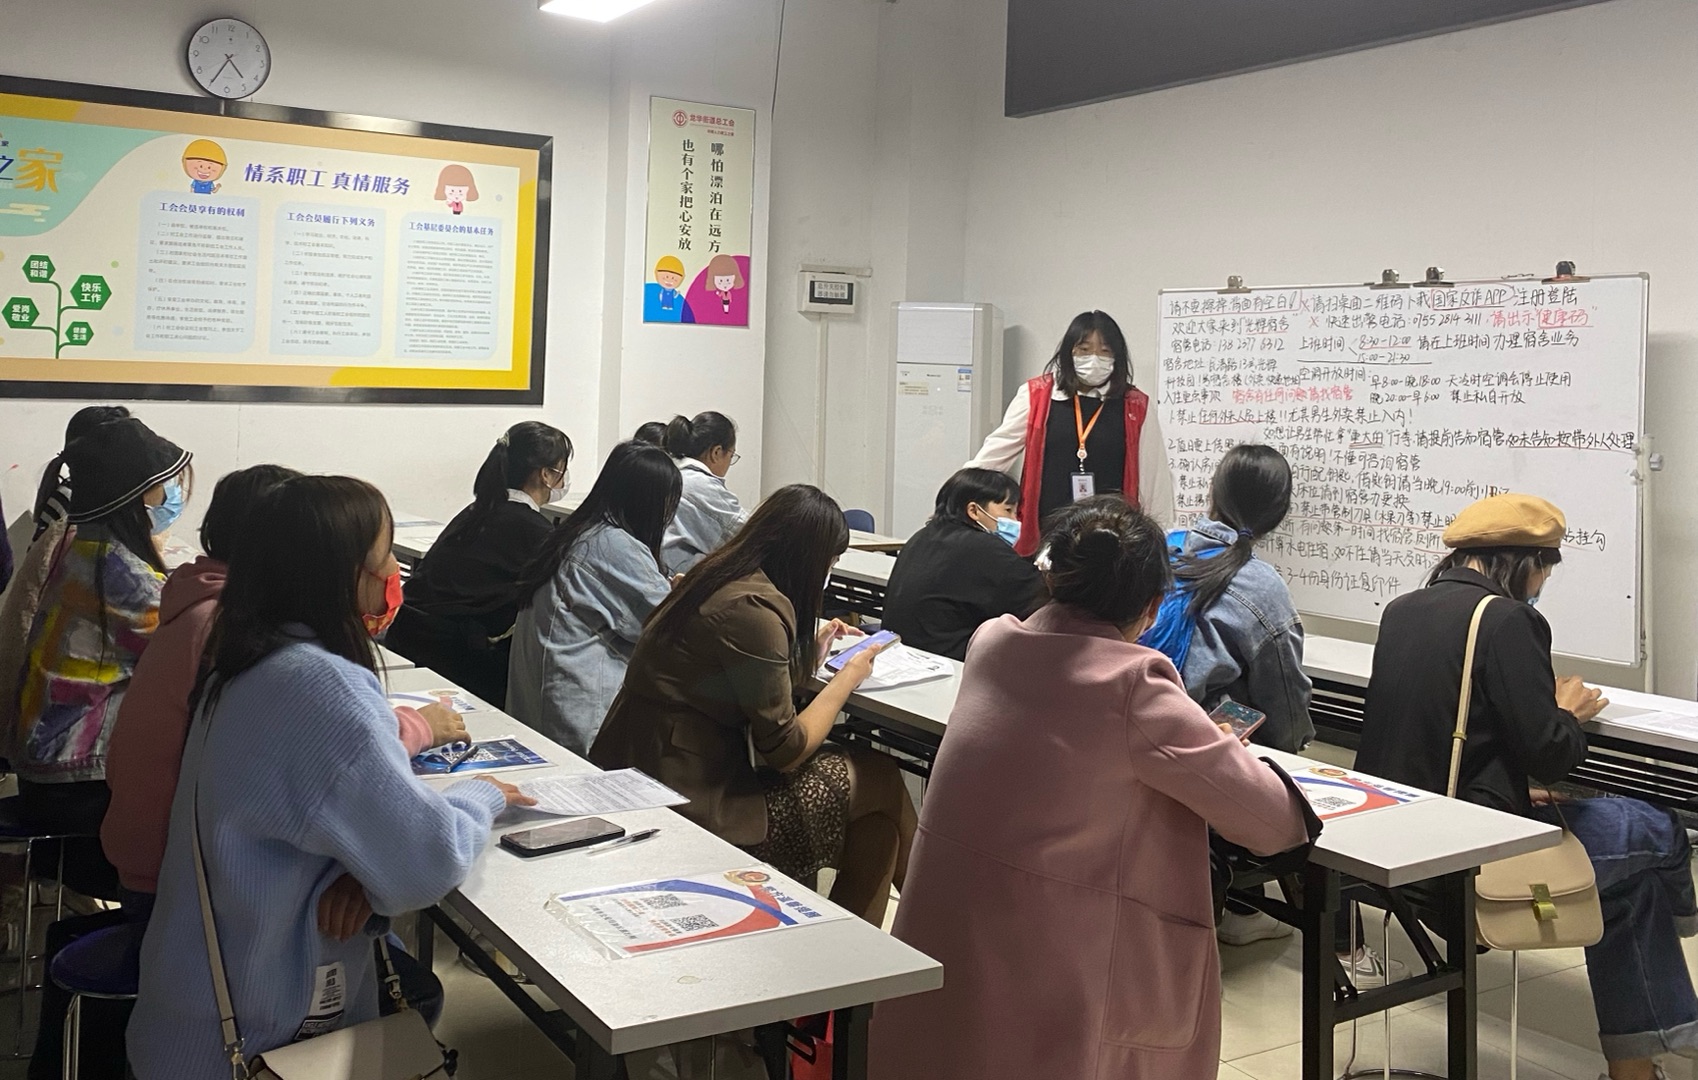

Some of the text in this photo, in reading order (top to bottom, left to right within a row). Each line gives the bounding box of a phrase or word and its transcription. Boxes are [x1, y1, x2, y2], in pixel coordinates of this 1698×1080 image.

[192, 49, 200, 58] 9
[255, 44, 261, 53] 2
[196, 65, 203, 75] 8
[223, 86, 231, 94] 6
[244, 163, 411, 196] 情系职工 真情服务
[678, 139, 695, 252] 也有个家把心安放
[708, 142, 725, 254] 哪怕漂泊在远方
[159, 202, 246, 217] 工会会员享有的权利
[287, 212, 376, 228] 工会会员履行下列义务
[409, 221, 494, 236] 工会基层委员会的基本任务
[80, 282, 102, 293] 快乐
[80, 293, 102, 303] 工作
[11, 304, 31, 314] 爱岗
[11, 313, 31, 323] 敬业
[1298, 334, 1346, 353] 上班时间
[1417, 329, 1580, 352] 请在上班时间办理宿舍业务
[1445, 371, 1572, 388] 天冷时空调会停止使用
[1449, 387, 1527, 405] 禁止私自开放
